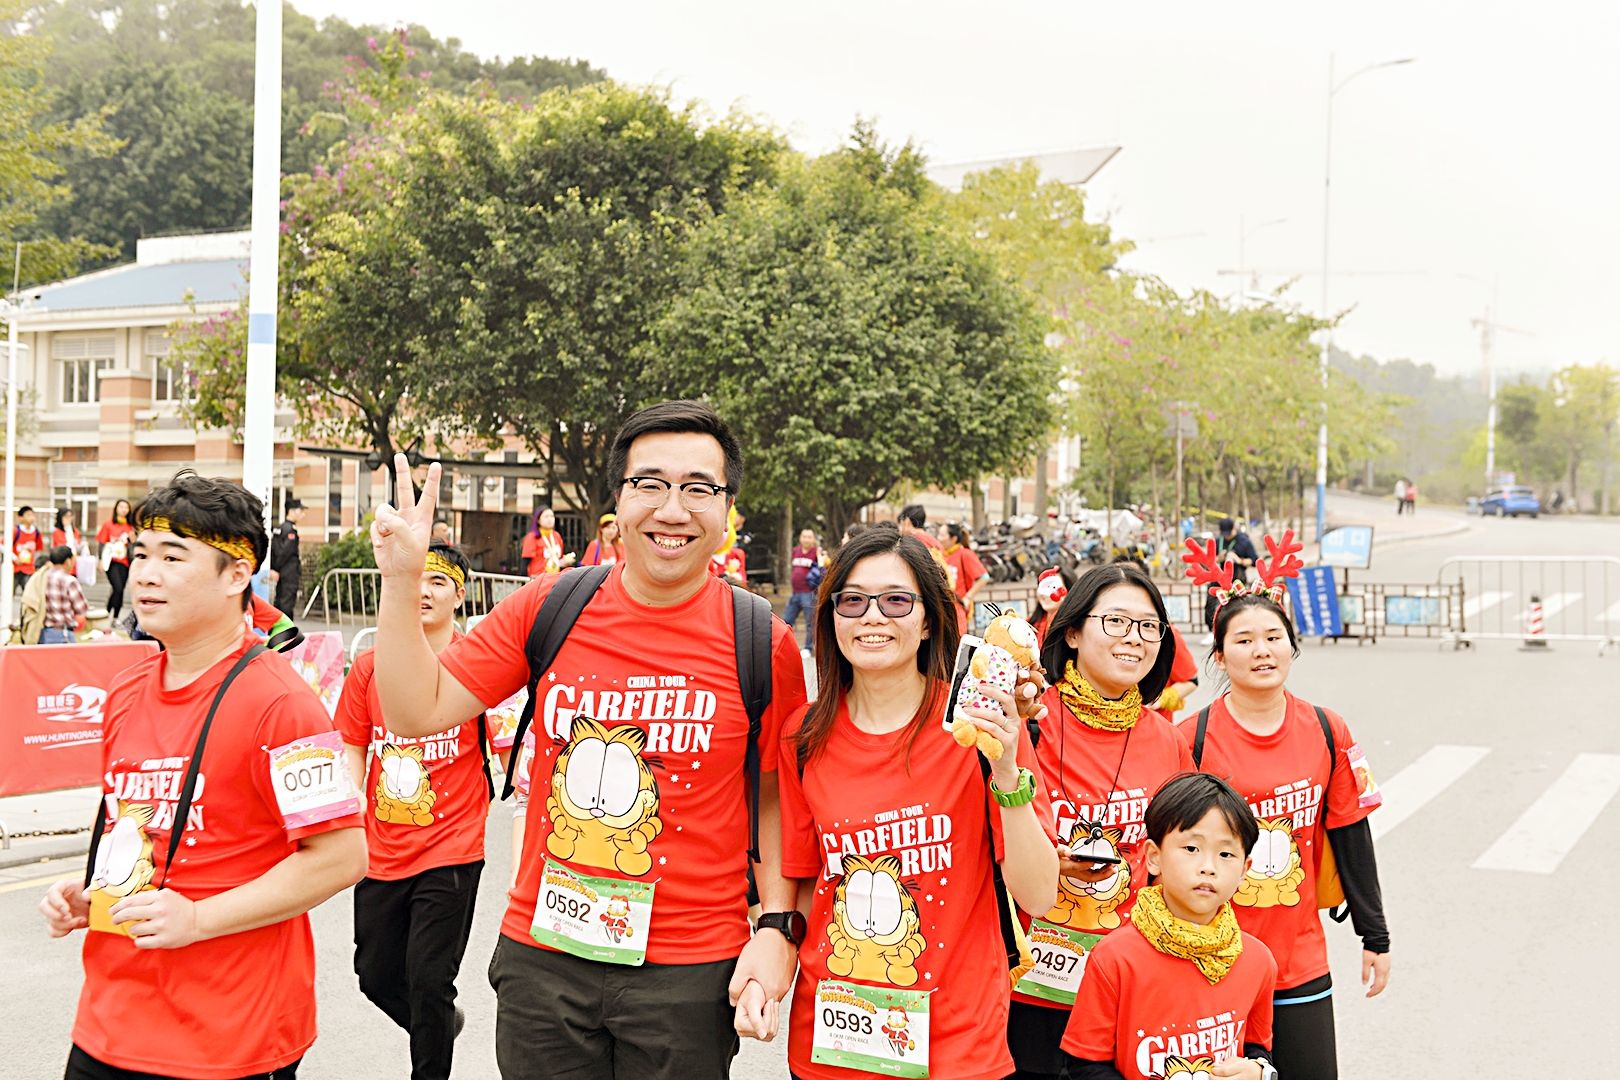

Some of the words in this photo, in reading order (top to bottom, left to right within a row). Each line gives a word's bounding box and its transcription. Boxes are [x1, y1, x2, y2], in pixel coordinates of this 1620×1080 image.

[1328, 530, 1366, 546] 出口
[627, 676, 656, 688] CHINA
[659, 675, 687, 687] TOUR
[543, 683, 717, 742] GARFIELD
[423, 738, 460, 761] RUN
[644, 722, 714, 753] RUN
[284, 762, 333, 792] 0077
[874, 810, 900, 824] CHINA
[900, 804, 924, 818] TOUR
[1249, 784, 1322, 818] ARFIELD
[822, 814, 953, 881] GARFIELD
[900, 842, 953, 877] RUN
[546, 890, 591, 923] 0592
[1031, 947, 1079, 974] 0497
[823, 1008, 873, 1035] 0593
